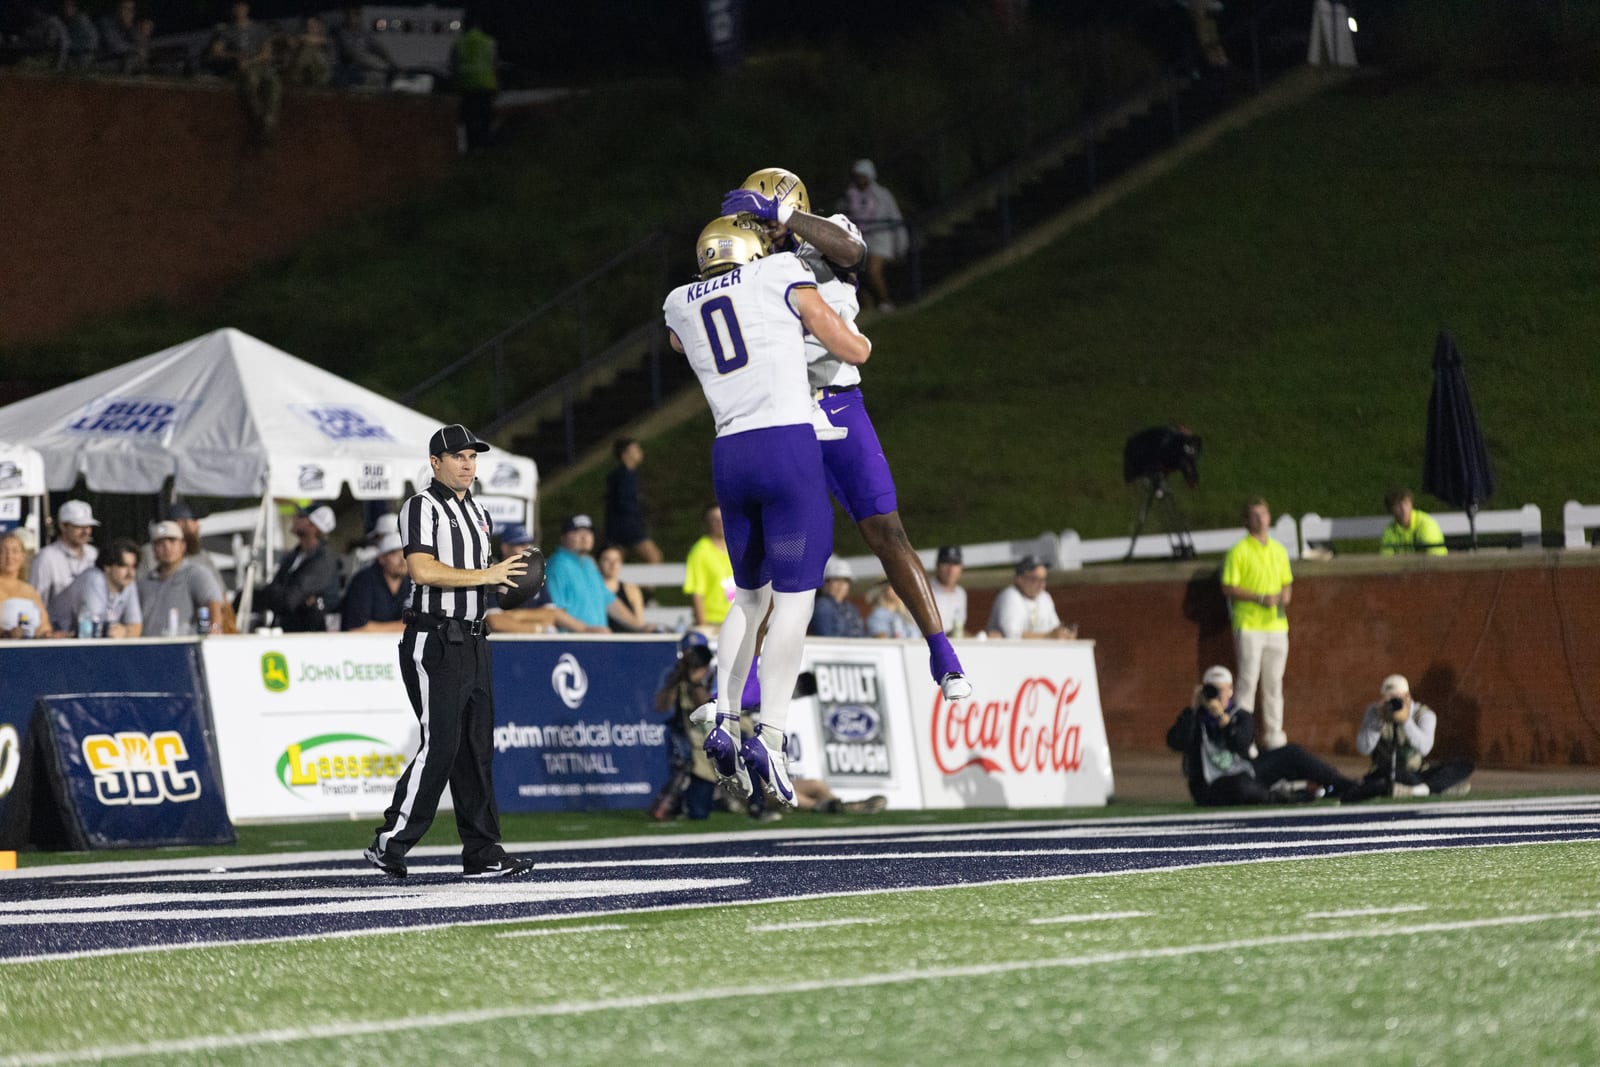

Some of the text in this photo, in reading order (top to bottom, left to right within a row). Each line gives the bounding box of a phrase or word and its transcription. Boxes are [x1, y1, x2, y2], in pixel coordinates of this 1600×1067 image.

[687, 268, 742, 303] KELLER
[701, 295, 749, 375] 0
[451, 518, 458, 528] S
[298, 660, 395, 682] JOHN DEERE
[815, 664, 878, 702] BUILT
[543, 719, 610, 747] medical
[611, 719, 667, 747] center
[82, 731, 201, 805] SBC
[287, 743, 406, 786] Lasseter
[826, 742, 889, 774] TOUGH
